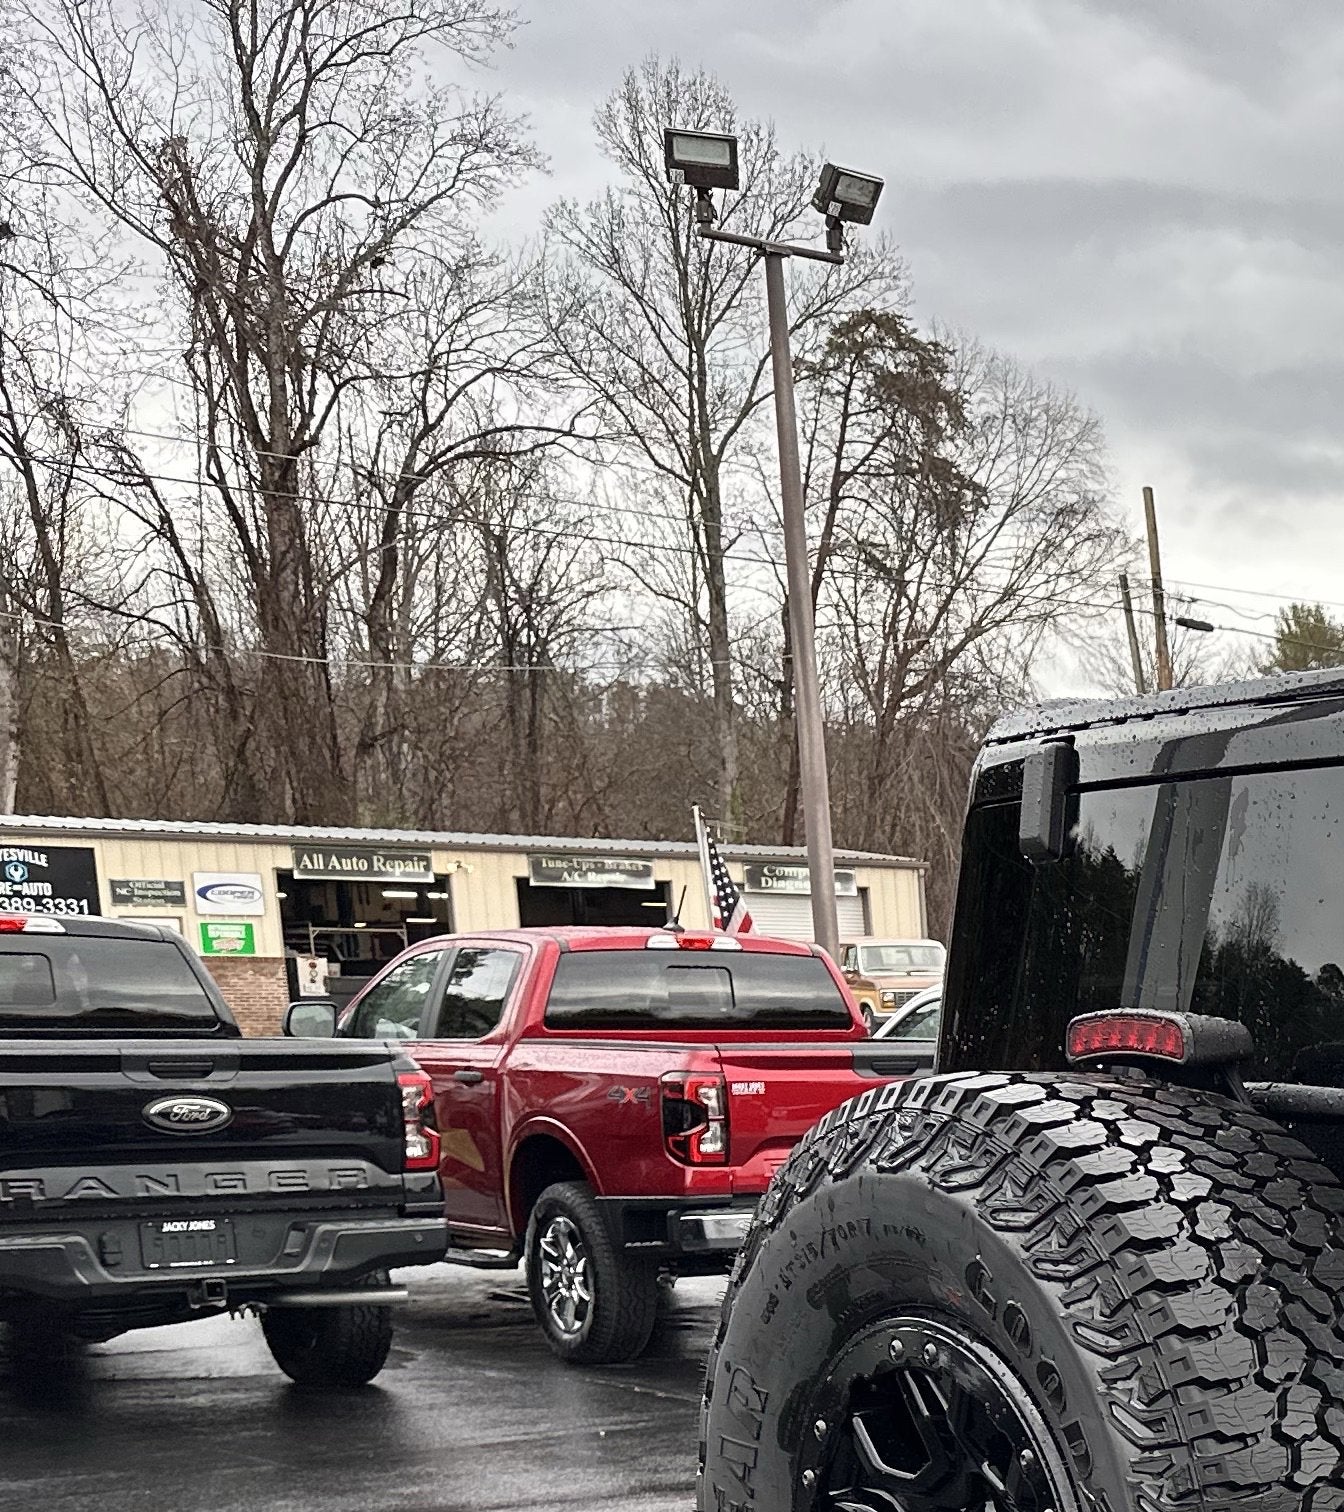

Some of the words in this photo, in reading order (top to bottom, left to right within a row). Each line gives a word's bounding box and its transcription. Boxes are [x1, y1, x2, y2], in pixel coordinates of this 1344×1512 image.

[300, 853, 324, 870] All
[328, 855, 368, 871] Auto
[373, 856, 427, 876] Repair
[0, 897, 89, 915] 389-3331
[170, 1105, 212, 1121] Ford
[0, 1168, 368, 1201] RANGER
[162, 1222, 188, 1232] JACKY
[189, 1220, 216, 1231] JONES
